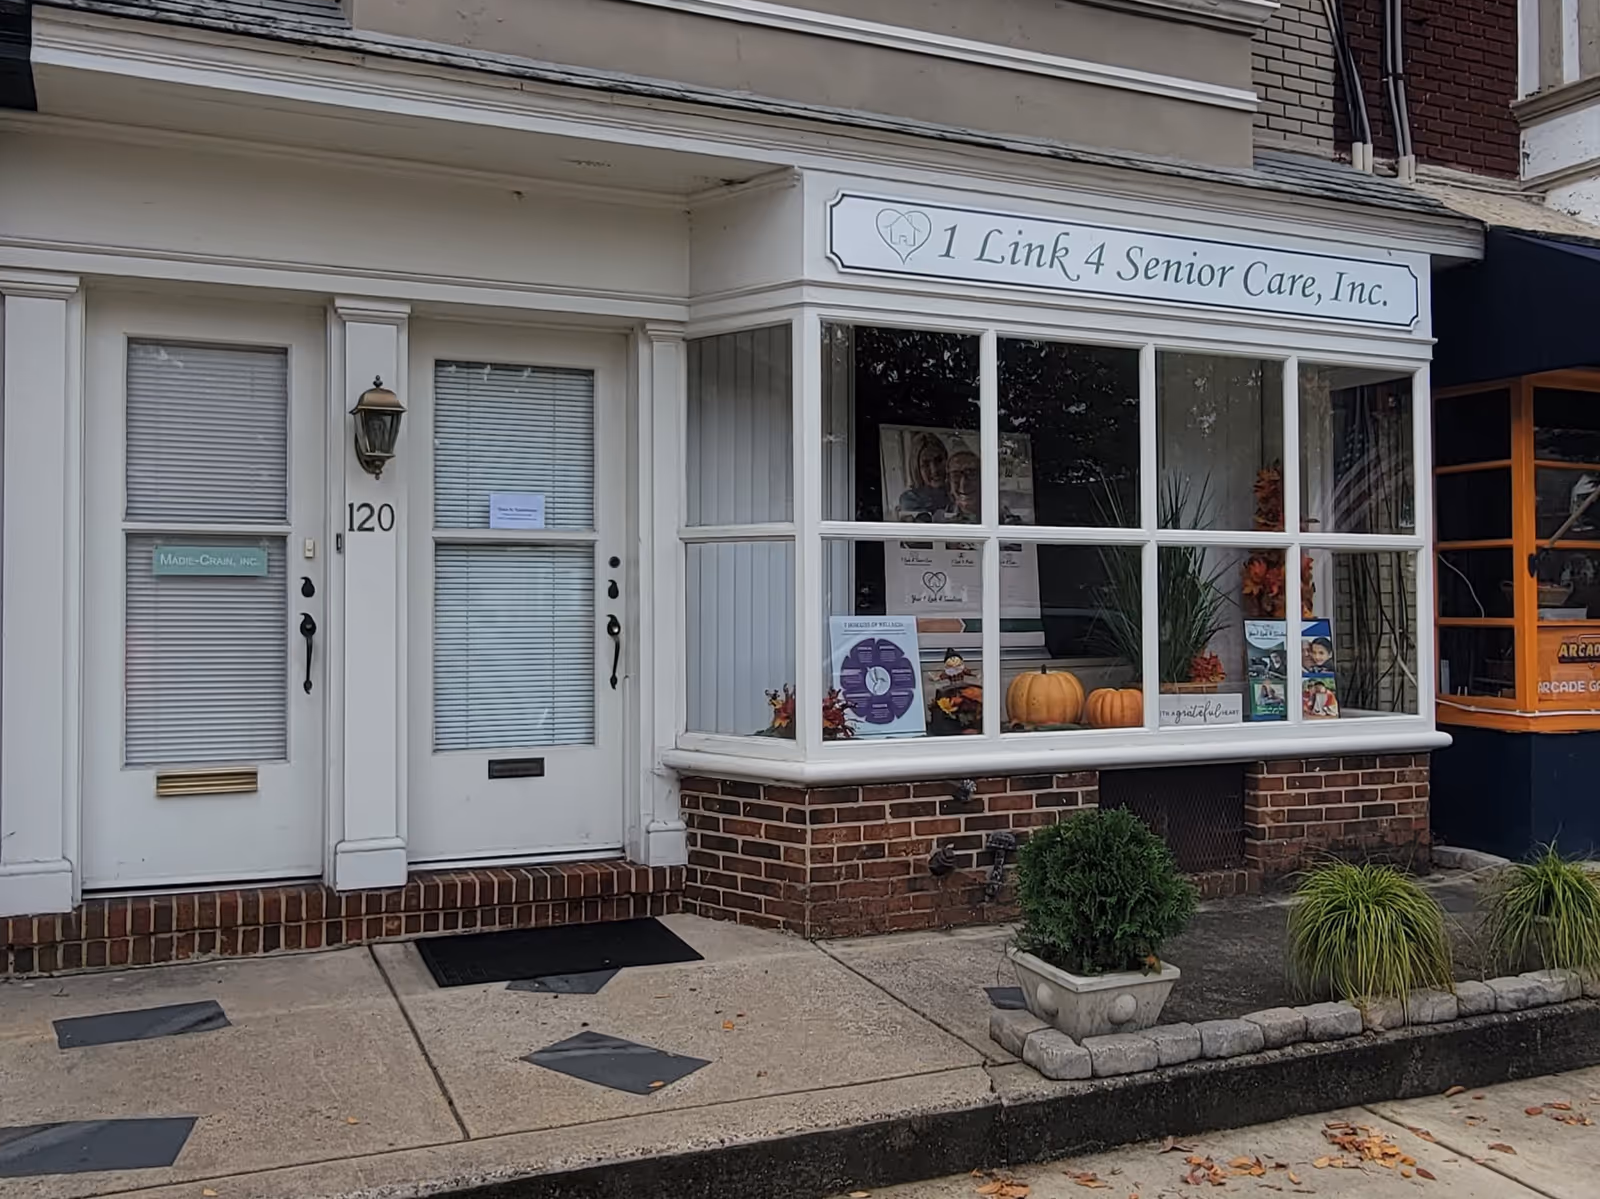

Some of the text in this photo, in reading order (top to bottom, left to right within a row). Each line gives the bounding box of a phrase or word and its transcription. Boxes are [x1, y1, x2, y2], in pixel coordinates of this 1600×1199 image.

[938, 223, 1389, 307] 1 Link 4 Senior Care, Inc.
[348, 502, 395, 532] 120
[1558, 643, 1600, 657] ARCAD
[1538, 680, 1600, 693] ARCADE GA
[1174, 701, 1222, 724] grateful
